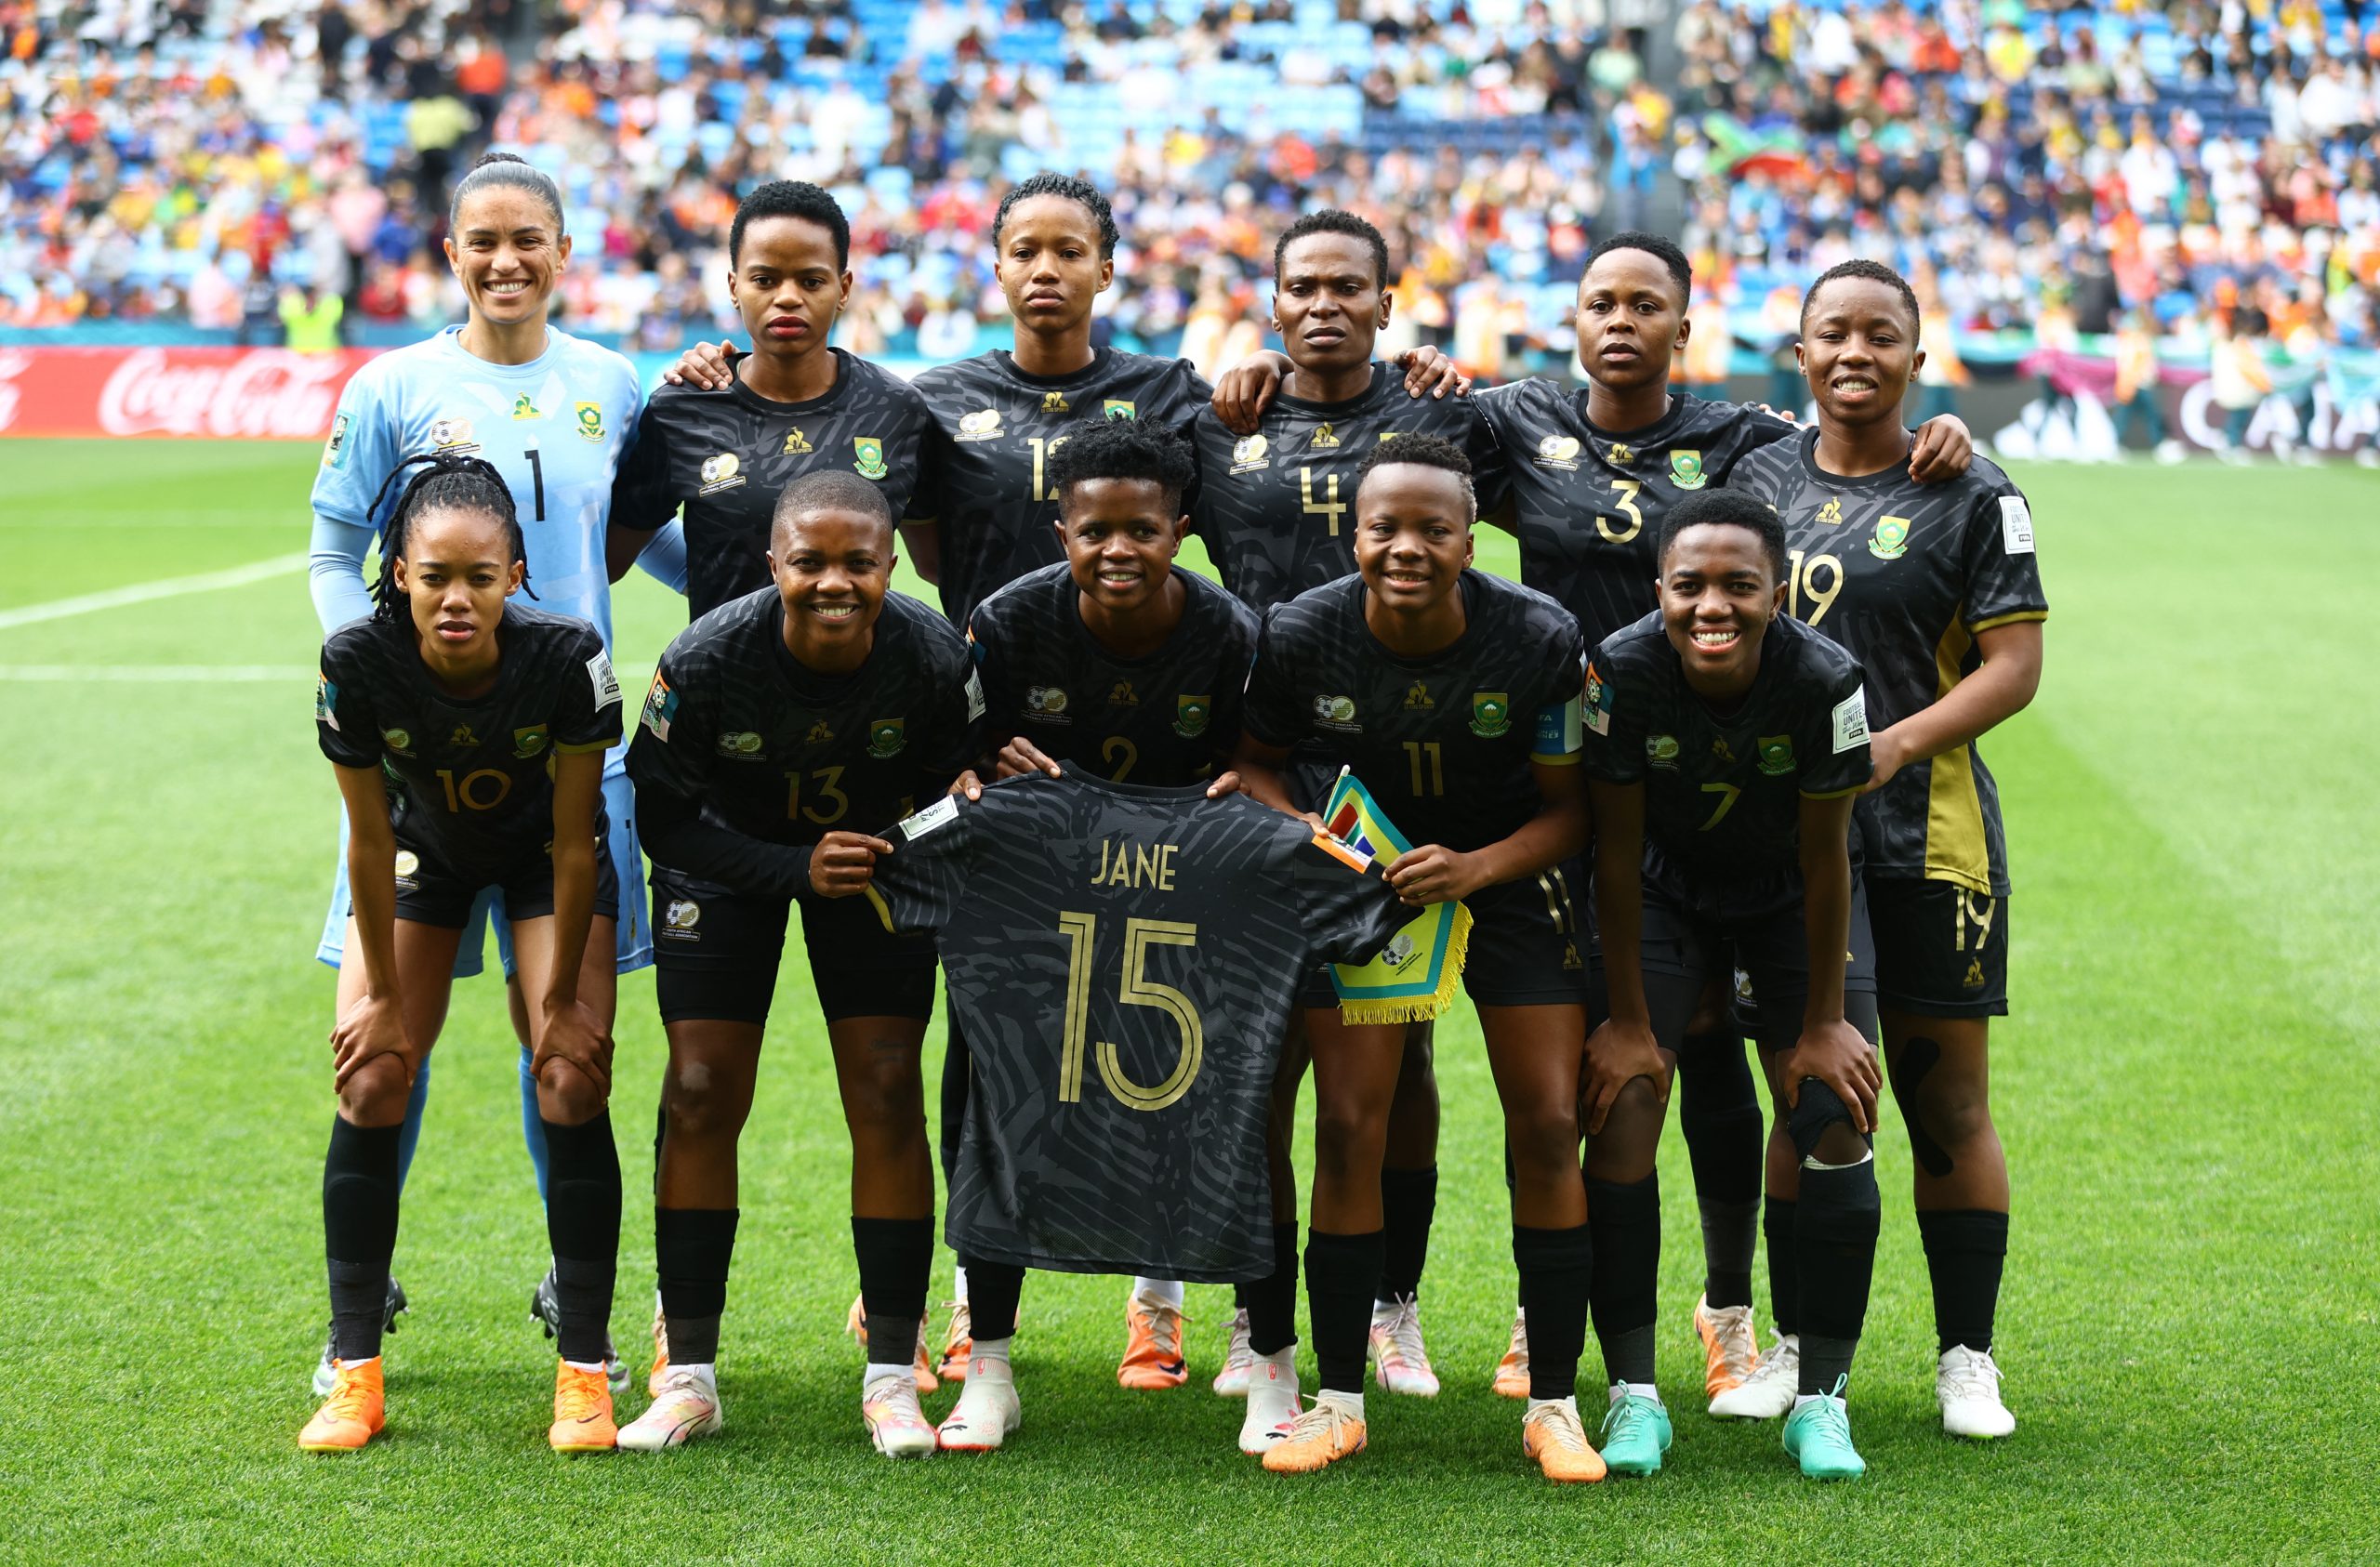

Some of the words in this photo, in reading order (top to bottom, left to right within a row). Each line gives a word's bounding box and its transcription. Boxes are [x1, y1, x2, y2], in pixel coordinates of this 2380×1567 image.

[98, 348, 345, 437] Coca-Cola
[524, 450, 545, 521] 1
[1028, 438, 1070, 502] 1
[1300, 467, 1346, 536] 4
[1595, 480, 1642, 545] 3
[1788, 549, 1844, 627] 19
[436, 769, 512, 813] 10
[1102, 736, 1138, 785] 2
[1402, 741, 1444, 798] 11
[785, 765, 850, 824] 13
[1698, 783, 1740, 831] 7
[1091, 839, 1179, 891] JANE
[1952, 884, 1996, 951] 19
[1059, 910, 1203, 1111] 15
